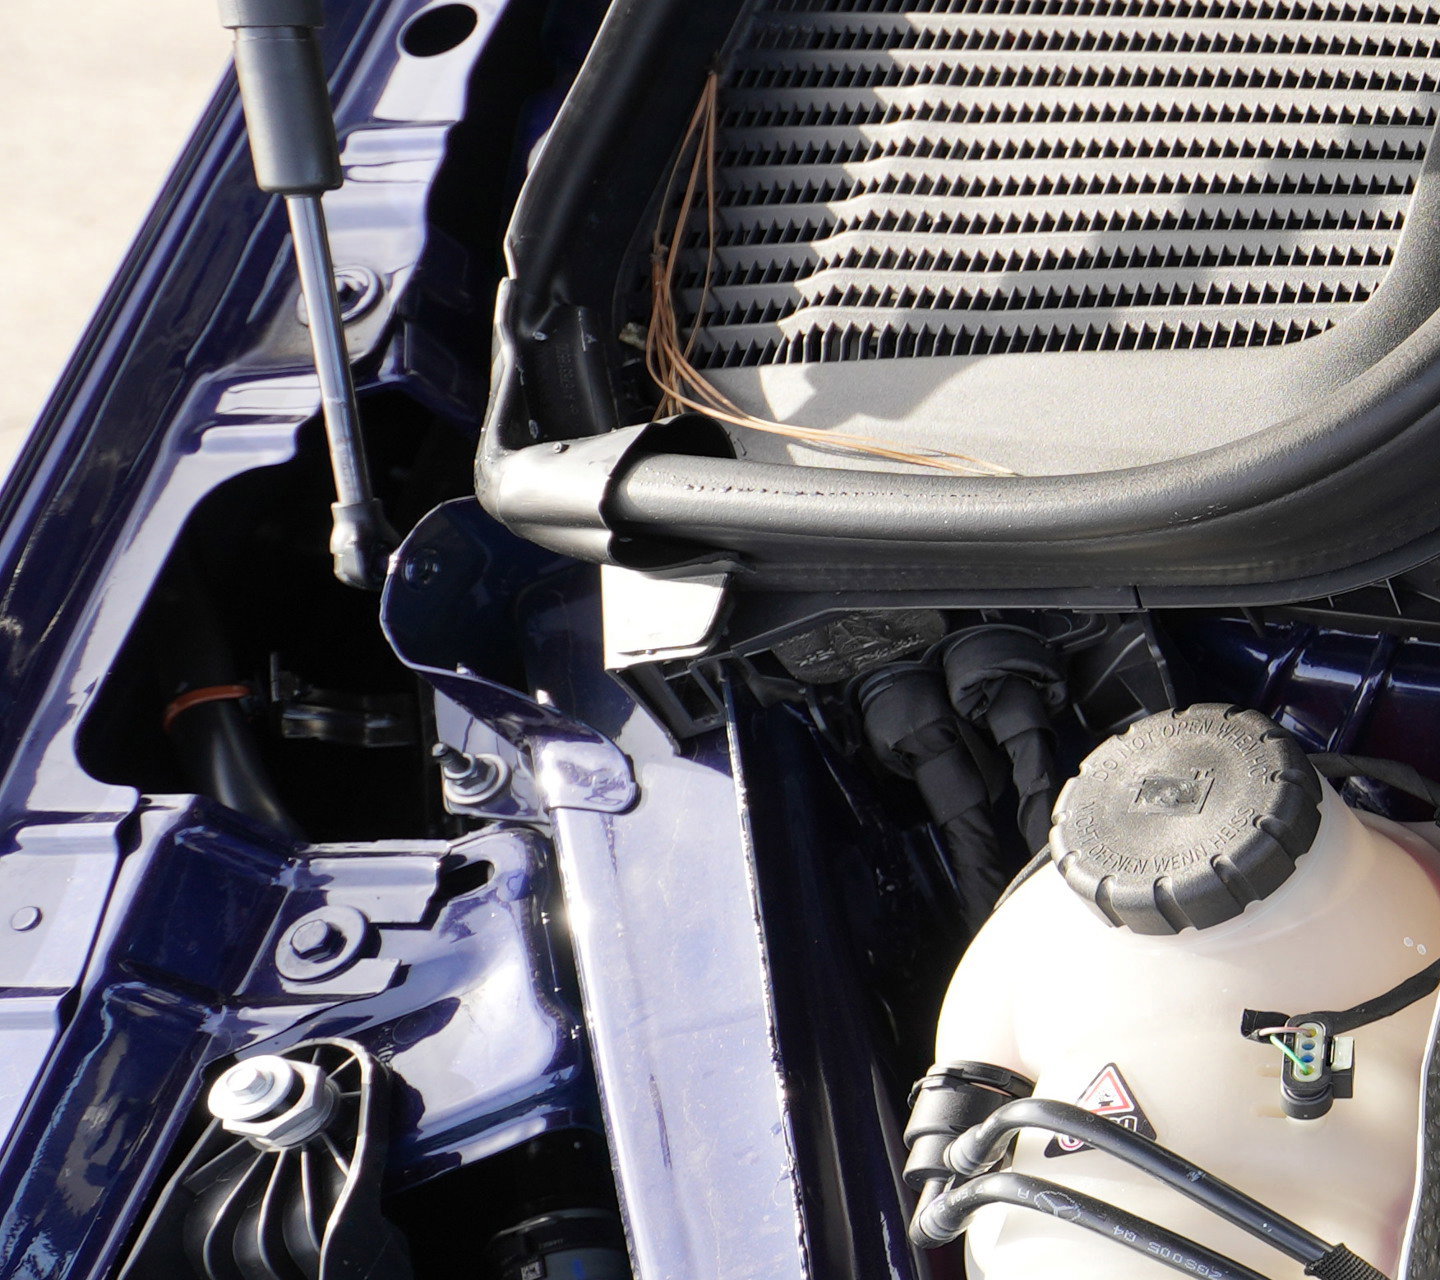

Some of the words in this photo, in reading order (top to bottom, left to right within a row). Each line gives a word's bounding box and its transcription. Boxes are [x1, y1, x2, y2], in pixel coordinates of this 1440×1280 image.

[1092, 759, 1118, 782] DO
[1121, 730, 1153, 759] NOT
[1162, 720, 1213, 736] OPEN
[1220, 721, 1261, 757] WHEN
[1153, 847, 1208, 873] WENN
[1214, 807, 1255, 849] HEISS
